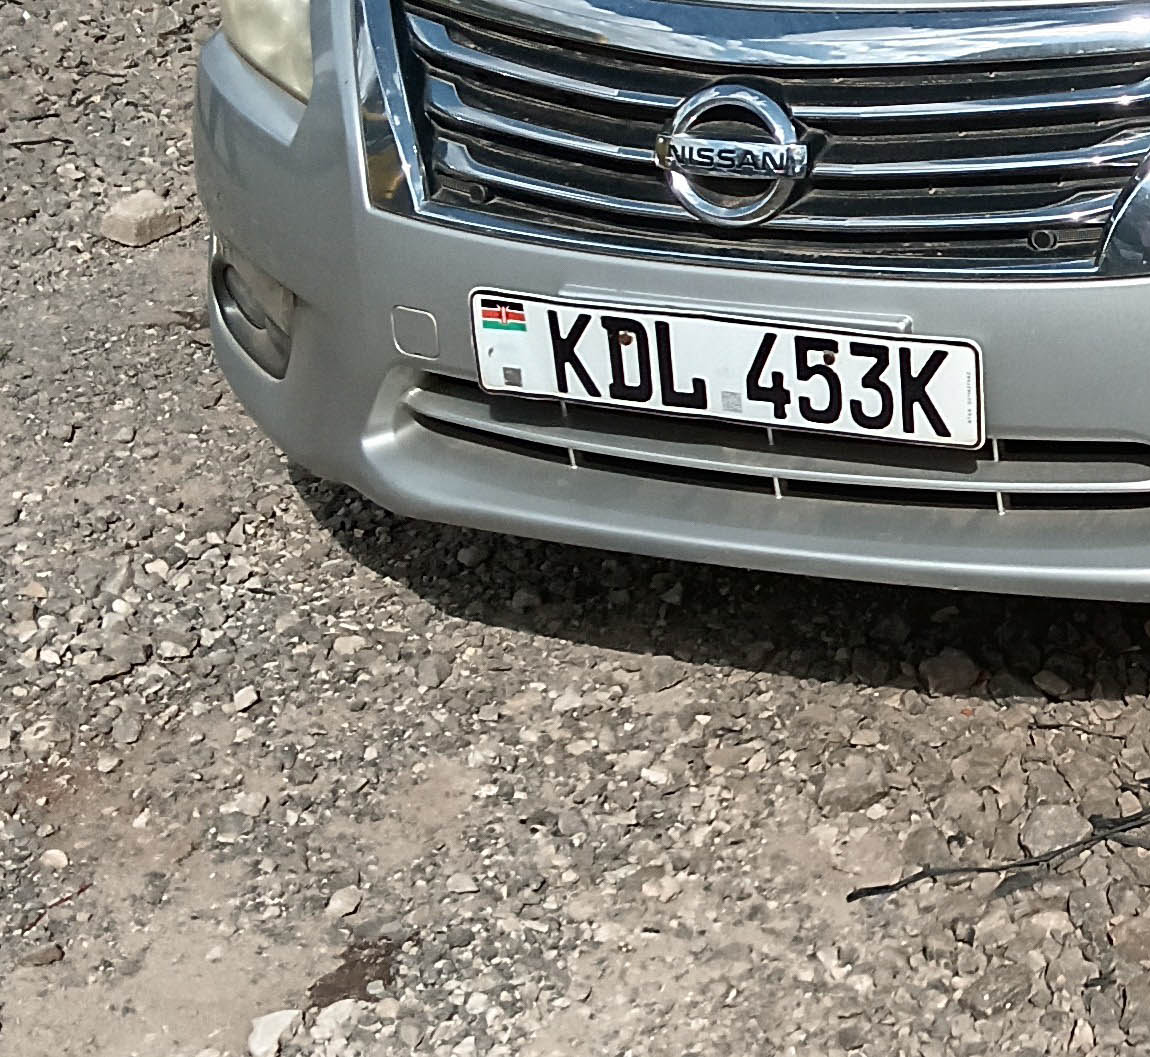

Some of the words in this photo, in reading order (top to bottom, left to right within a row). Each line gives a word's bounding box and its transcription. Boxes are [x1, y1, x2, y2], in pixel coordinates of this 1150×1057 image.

[668, 144, 785, 173] NISSAN
[546, 309, 708, 411] KDL
[745, 332, 952, 439] 453K
